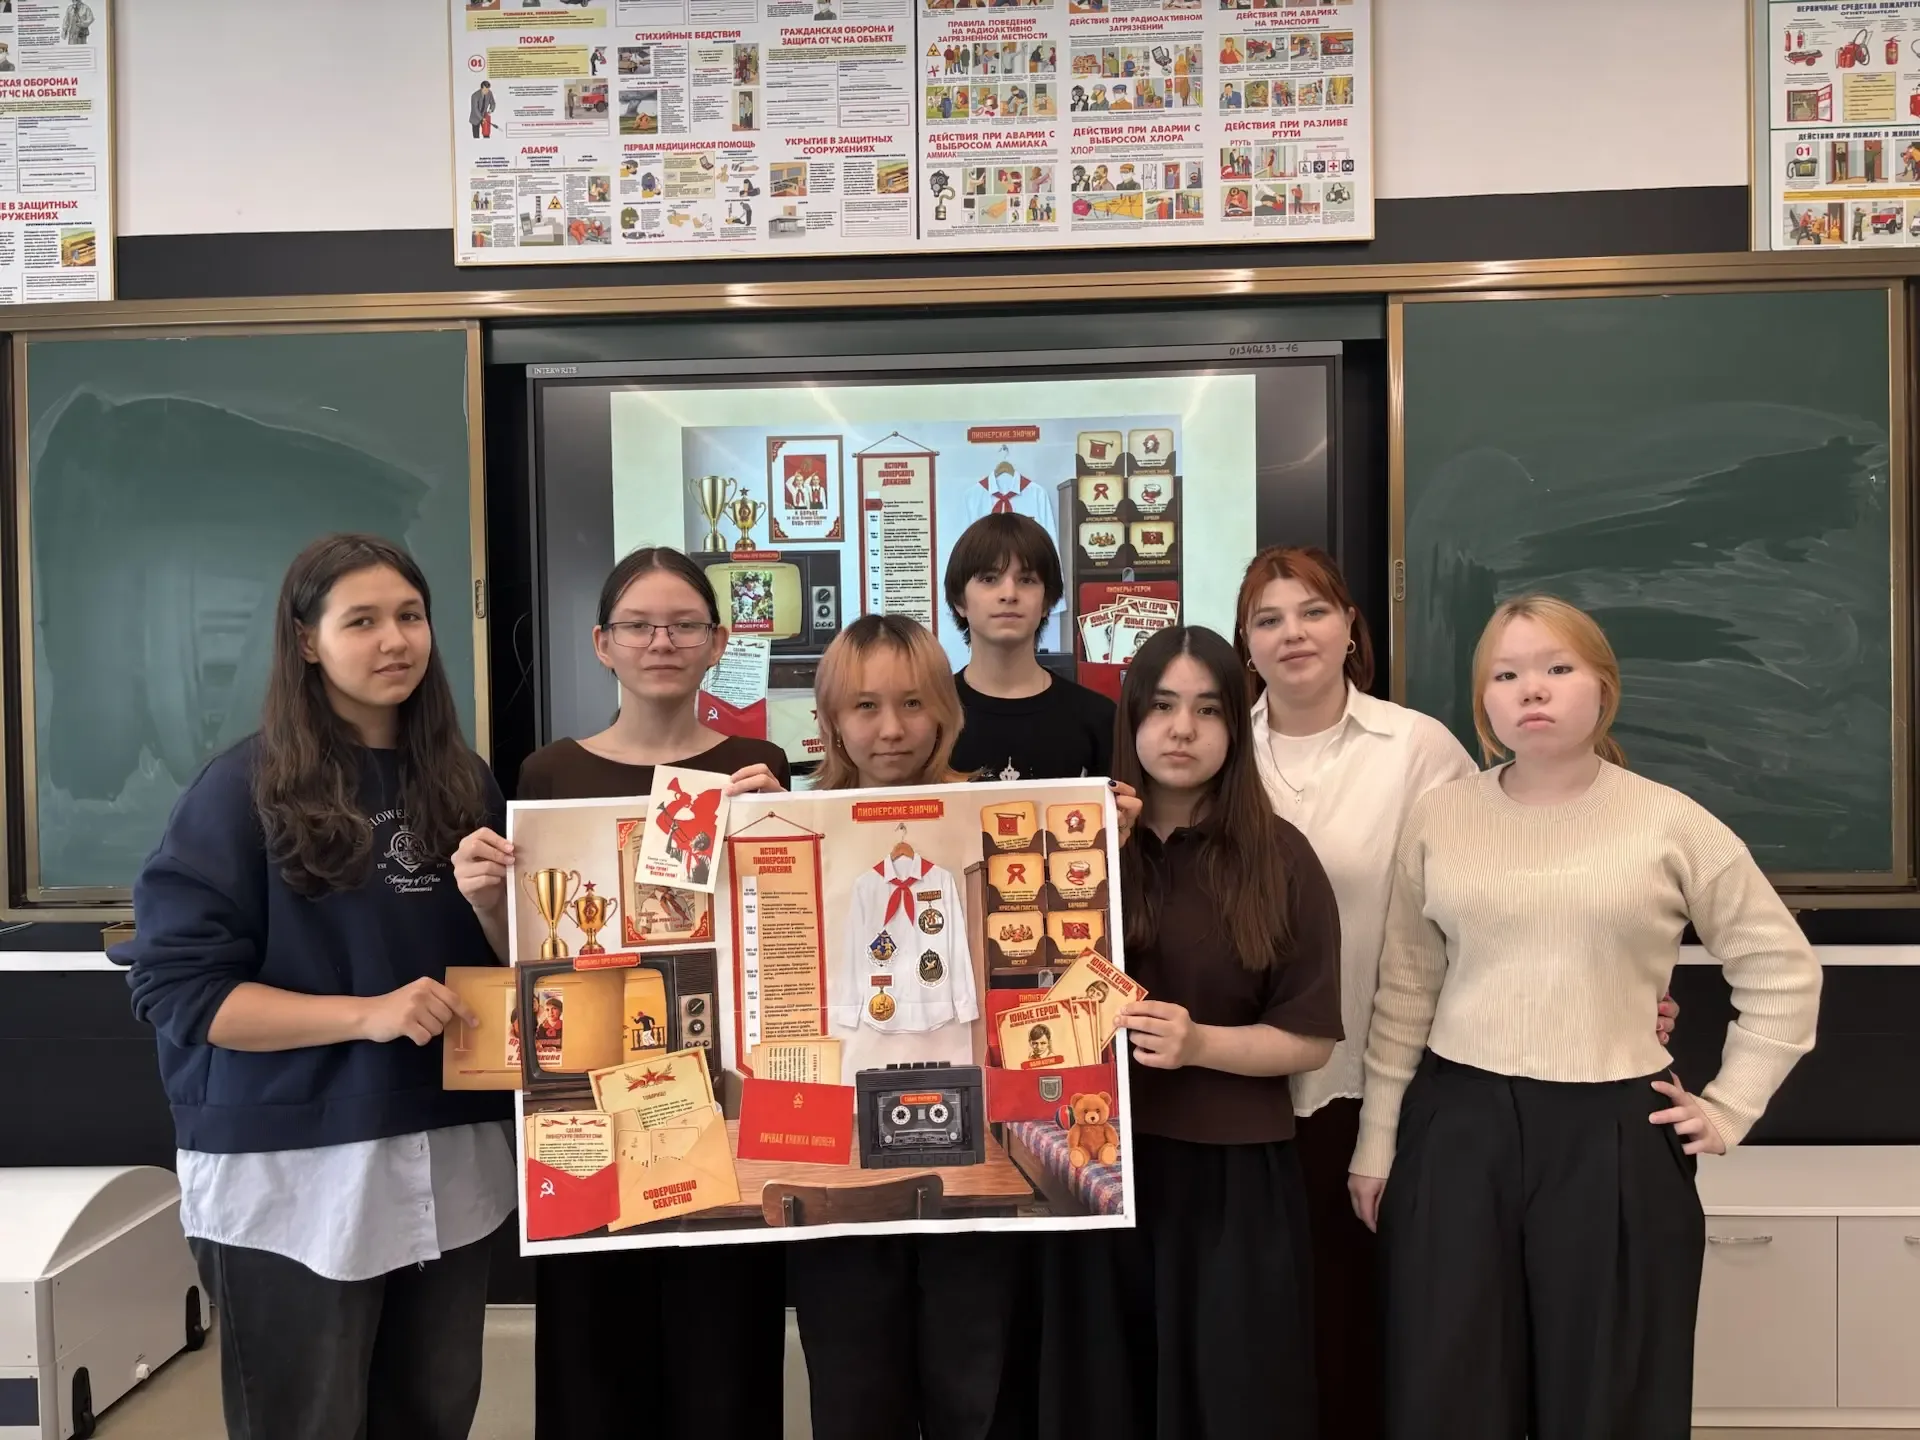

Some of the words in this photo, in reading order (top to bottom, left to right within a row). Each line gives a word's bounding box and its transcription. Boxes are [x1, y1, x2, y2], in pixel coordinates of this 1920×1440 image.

[1841, 3, 1877, 11] СРЕДСТВА
[1236, 11, 1278, 20] ДЕЙСТВИЯ
[1300, 9, 1338, 17] АВАРИЯХ
[948, 20, 986, 28] ПРАВИЛА
[988, 18, 1037, 27] ПОВЕДЕНИЯ
[1069, 17, 1109, 26] ДЕЙСТВИЯ
[1112, 16, 1127, 24] ПРИ
[1130, 14, 1203, 23] РАДИОАКТИВНОМ
[1270, 18, 1320, 26] ТРАНСПОРТЕ
[780, 26, 843, 36] ГРАЖДАНСКАЯ
[844, 25, 887, 34] ОБОРОНА
[888, 25, 894, 33] И
[952, 27, 964, 35] НА
[966, 26, 1033, 35] РАДИОАКТИВНО
[1109, 23, 1163, 32] ЗАГРЯЗНЕНИИ
[519, 35, 555, 44] ПОЖАР
[635, 31, 692, 41] СТИХИЙНЫЕ
[694, 30, 741, 39] БЕДСТВИЯ
[782, 36, 817, 46] ЗАЩИТА
[818, 36, 830, 44] ОТ
[831, 36, 842, 44] ЧС
[843, 36, 856, 44] НА
[857, 34, 893, 43] ОБЪЕКТЕ
[937, 34, 999, 43] ЗАГРЯЗНЕННОЙ
[1001, 32, 1048, 41] МЕСТНОСТИ
[470, 58, 482, 68] 01
[0, 79, 21, 87] СКАЯ
[23, 77, 69, 87] ОБОРОНА
[71, 77, 78, 86] И
[9, 89, 20, 98] ЧС
[22, 89, 35, 97] НА
[37, 88, 77, 97] ОБЪЕКТЕ
[1225, 121, 1276, 132] ДЕЙСТВИЯ
[1280, 120, 1300, 129] ПРИ
[1303, 118, 1348, 127] РАЗЛИВЕ
[1073, 127, 1123, 137] ДЕЙСТВИЯ
[1127, 126, 1147, 135] ПРИ
[1151, 125, 1191, 133] АВАРИИ
[1194, 124, 1200, 132] С
[1272, 129, 1301, 138] РТУТИ
[785, 137, 828, 146] УКРЫТИЕ
[830, 136, 836, 145] В
[837, 135, 893, 145] ЗАЩИТНЫХ
[929, 132, 979, 143] ДЕЙСТВИЯ
[982, 132, 1002, 141] ПРИ
[1005, 131, 1046, 140] АВАРИИ
[1049, 130, 1055, 138] С
[1089, 135, 1146, 145] ВЫБРОСОМ
[1150, 134, 1184, 143] ХЛОРА
[624, 143, 654, 152] ПЕРВАЯ
[656, 141, 716, 151] МЕДИЦИНСКАЯ
[717, 140, 756, 150] ПОМОЩЬ
[936, 141, 992, 150] ВЫБРОСОМ
[995, 140, 1048, 149] АММИАКА
[1230, 139, 1252, 147] РТУТЬ
[521, 146, 558, 154] АВАРИЯ
[803, 145, 875, 154] СООРУЖЕНИЯХ
[1070, 147, 1093, 155] ХЛОР
[1796, 146, 1810, 156] 01
[926, 151, 957, 159] АММИАК
[9, 202, 15, 210] В
[18, 200, 78, 210] ЗАЩИТНЫХ
[0, 211, 59, 221] РУЖЕНИЯХ
[534, 367, 577, 375] INTERWRITE
[971, 430, 1011, 439] ПИОНЕРСКИЕ
[1012, 429, 1036, 438] ЗНАЧКИ
[1124, 617, 1145, 626] ЮНЫЕ
[857, 806, 909, 817] ПИОНЕРСКИЕ
[909, 804, 938, 815] ЗНАЧКИ
[760, 847, 788, 855] ИСТОРИЯ
[753, 856, 796, 865] ПИОНЕРСКОГО
[1090, 956, 1114, 977] ЮНЫЕ
[1111, 972, 1134, 993] ГЕРОИ
[1009, 1008, 1034, 1024] ЮНЫЕ
[1035, 1004, 1059, 1018] ГЕРОИ
[760, 1132, 783, 1144] ЛИЧНАЯ
[785, 1134, 810, 1145] КНИЖКА
[643, 1179, 698, 1201] СОВЕРШЕННО
[652, 1192, 692, 1210] СЕКРЕТНО
